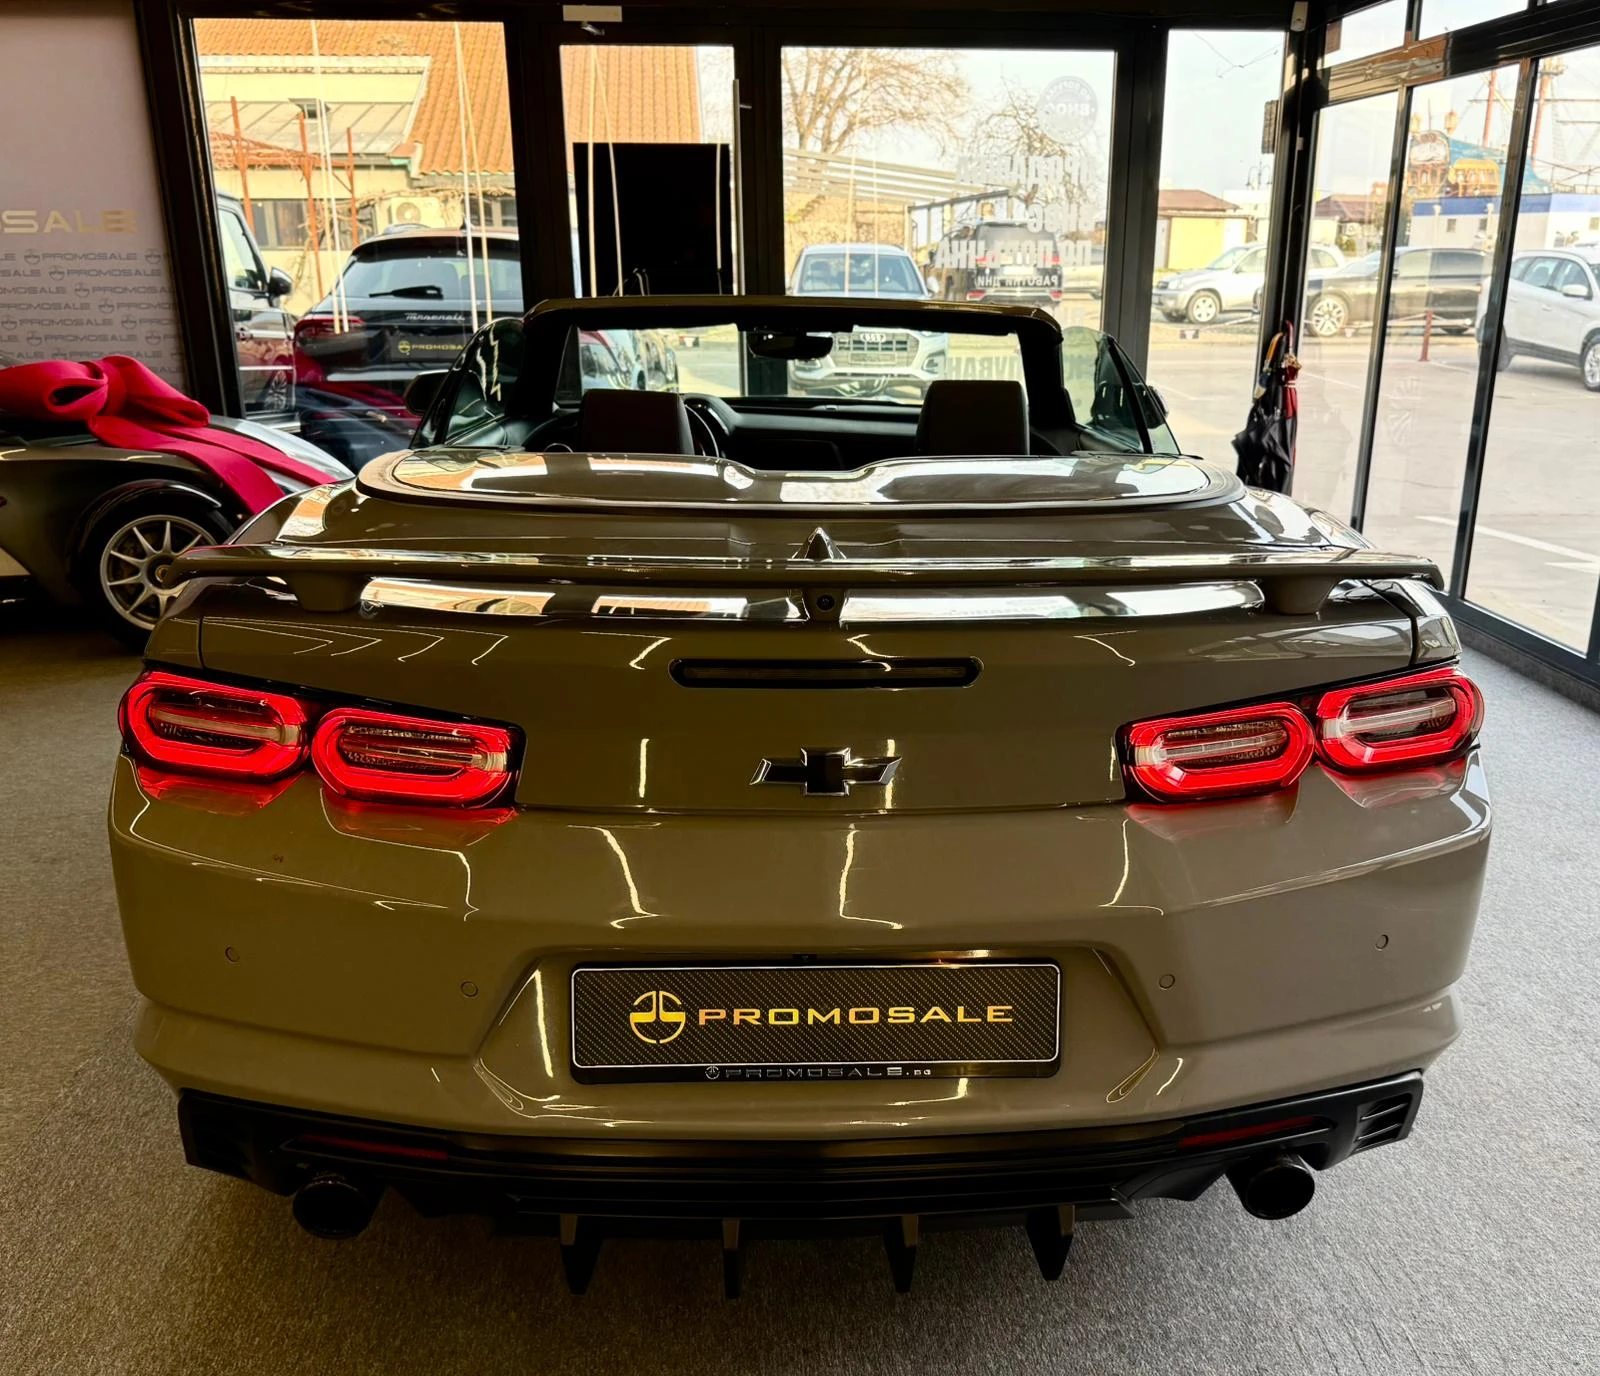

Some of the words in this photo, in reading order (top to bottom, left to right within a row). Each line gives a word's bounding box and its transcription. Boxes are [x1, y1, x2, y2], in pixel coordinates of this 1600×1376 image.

[0, 210, 138, 234] SALE
[42, 253, 137, 261] PROMOSALE
[67, 269, 162, 277] PROMOSALE
[19, 318, 113, 327] PROMOSALE
[44, 334, 138, 342] PROMOSALE
[698, 1005, 1013, 1025] PROMOSALE
